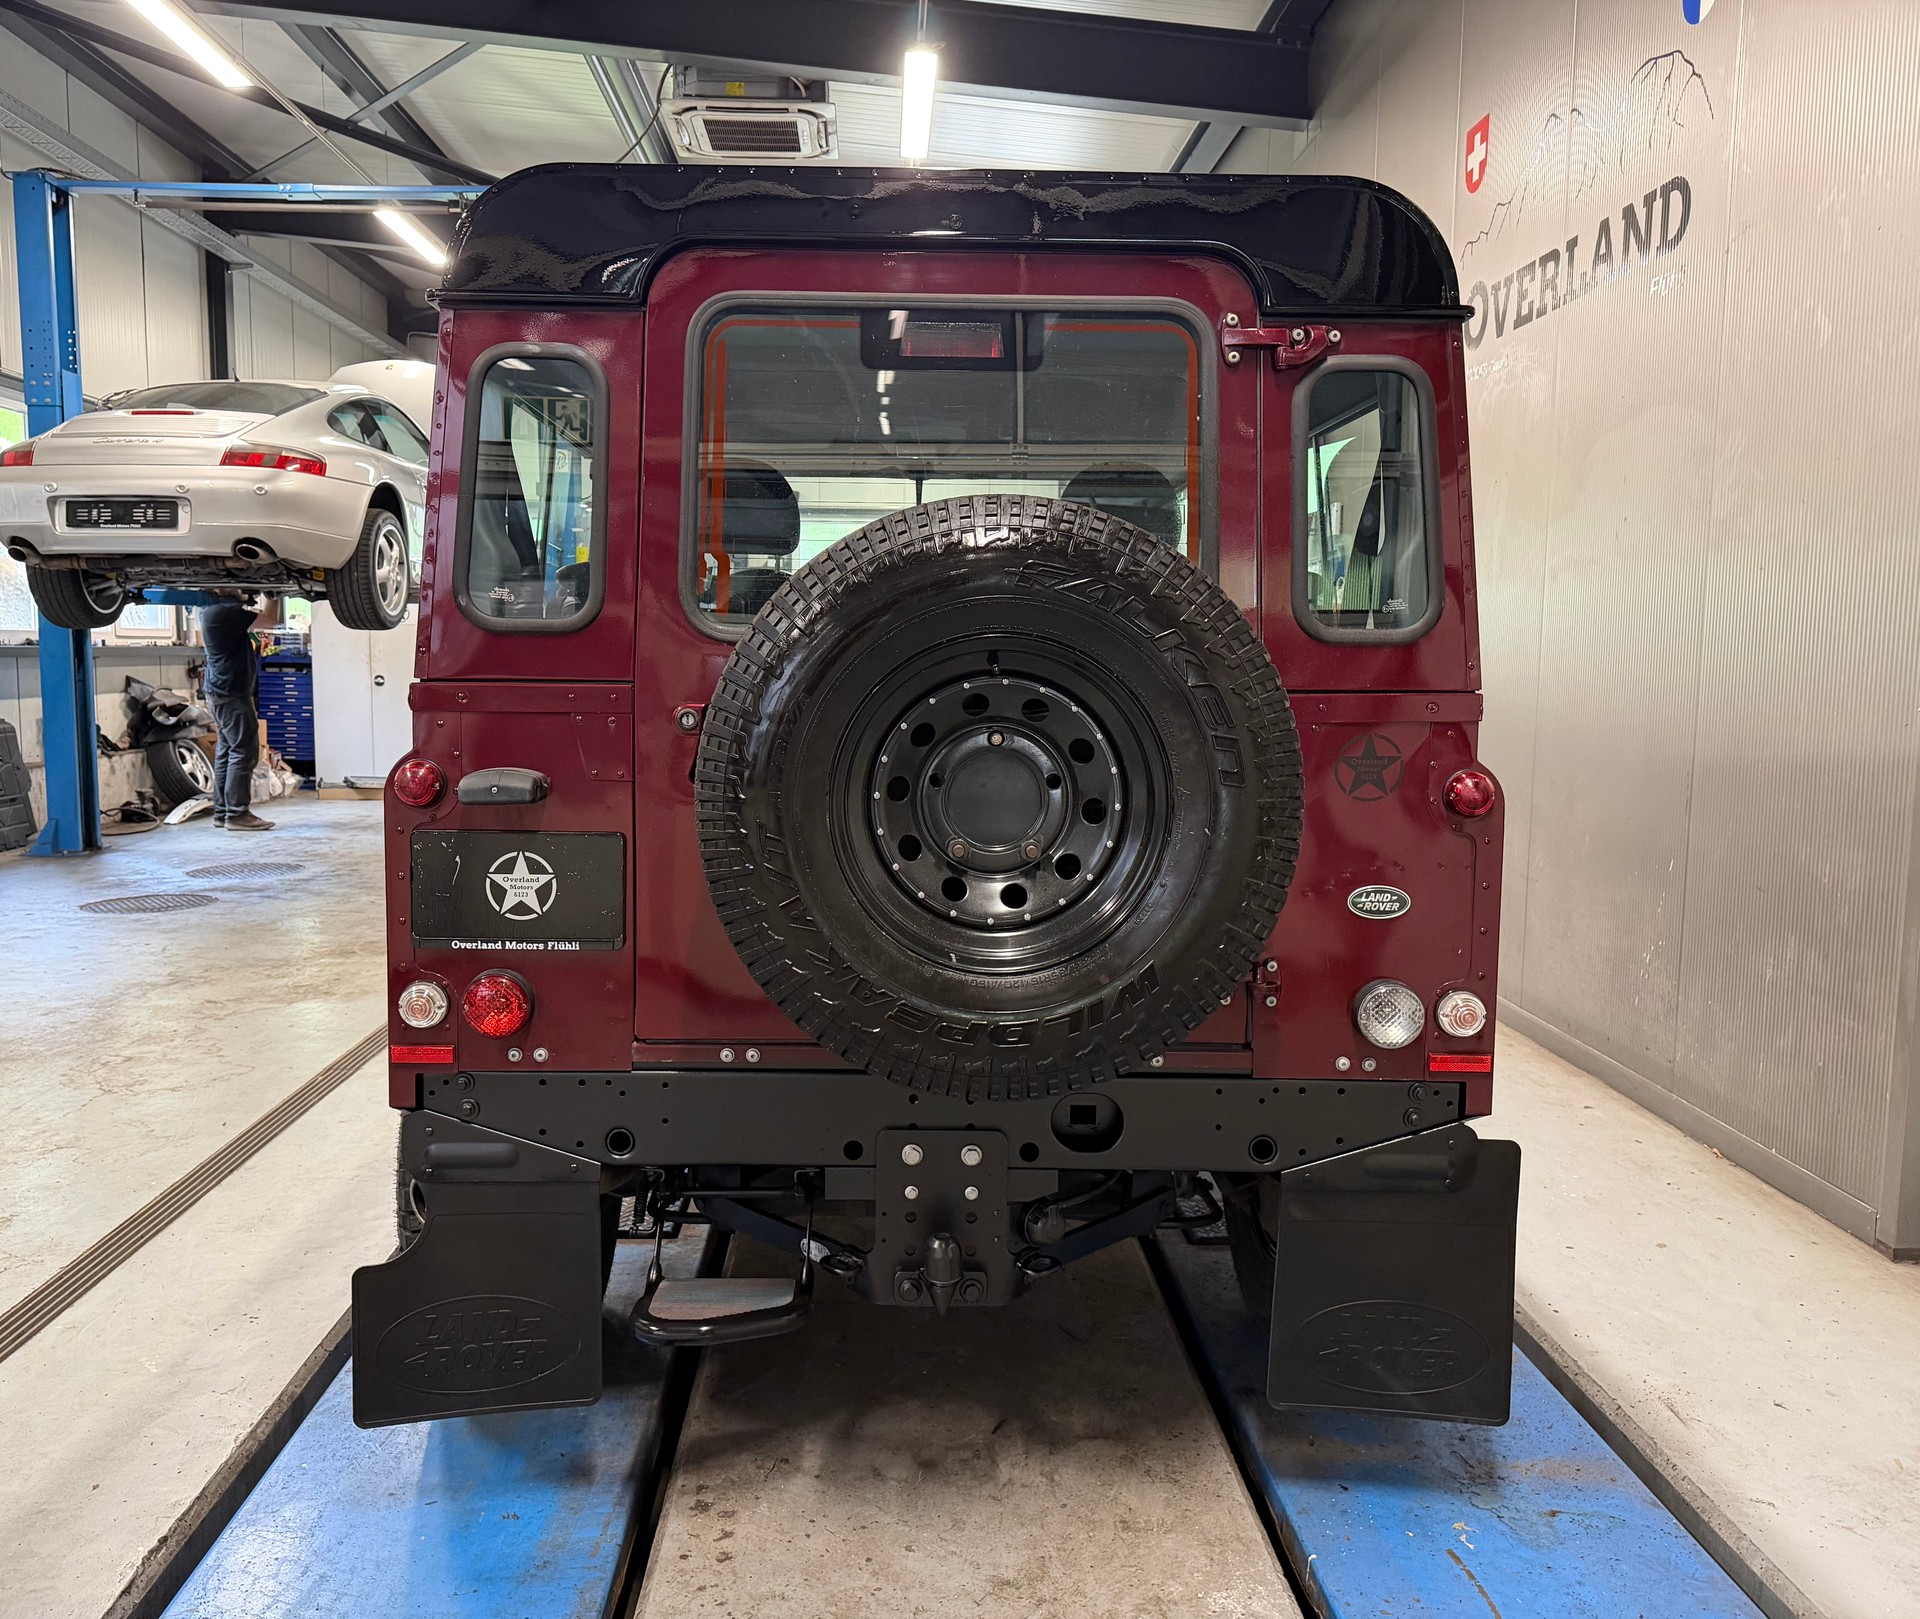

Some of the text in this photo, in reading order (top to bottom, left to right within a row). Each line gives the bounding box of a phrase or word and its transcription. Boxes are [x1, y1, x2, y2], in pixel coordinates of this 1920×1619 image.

[1463, 175, 1691, 351] OVERLAND
[1003, 559, 1248, 788] FALKEN
[1360, 892, 1392, 902] LAND
[1363, 902, 1400, 911] ROVER
[451, 940, 580, 950] Overland Motors Flühli
[806, 942, 1160, 1049] WILDPEAK
